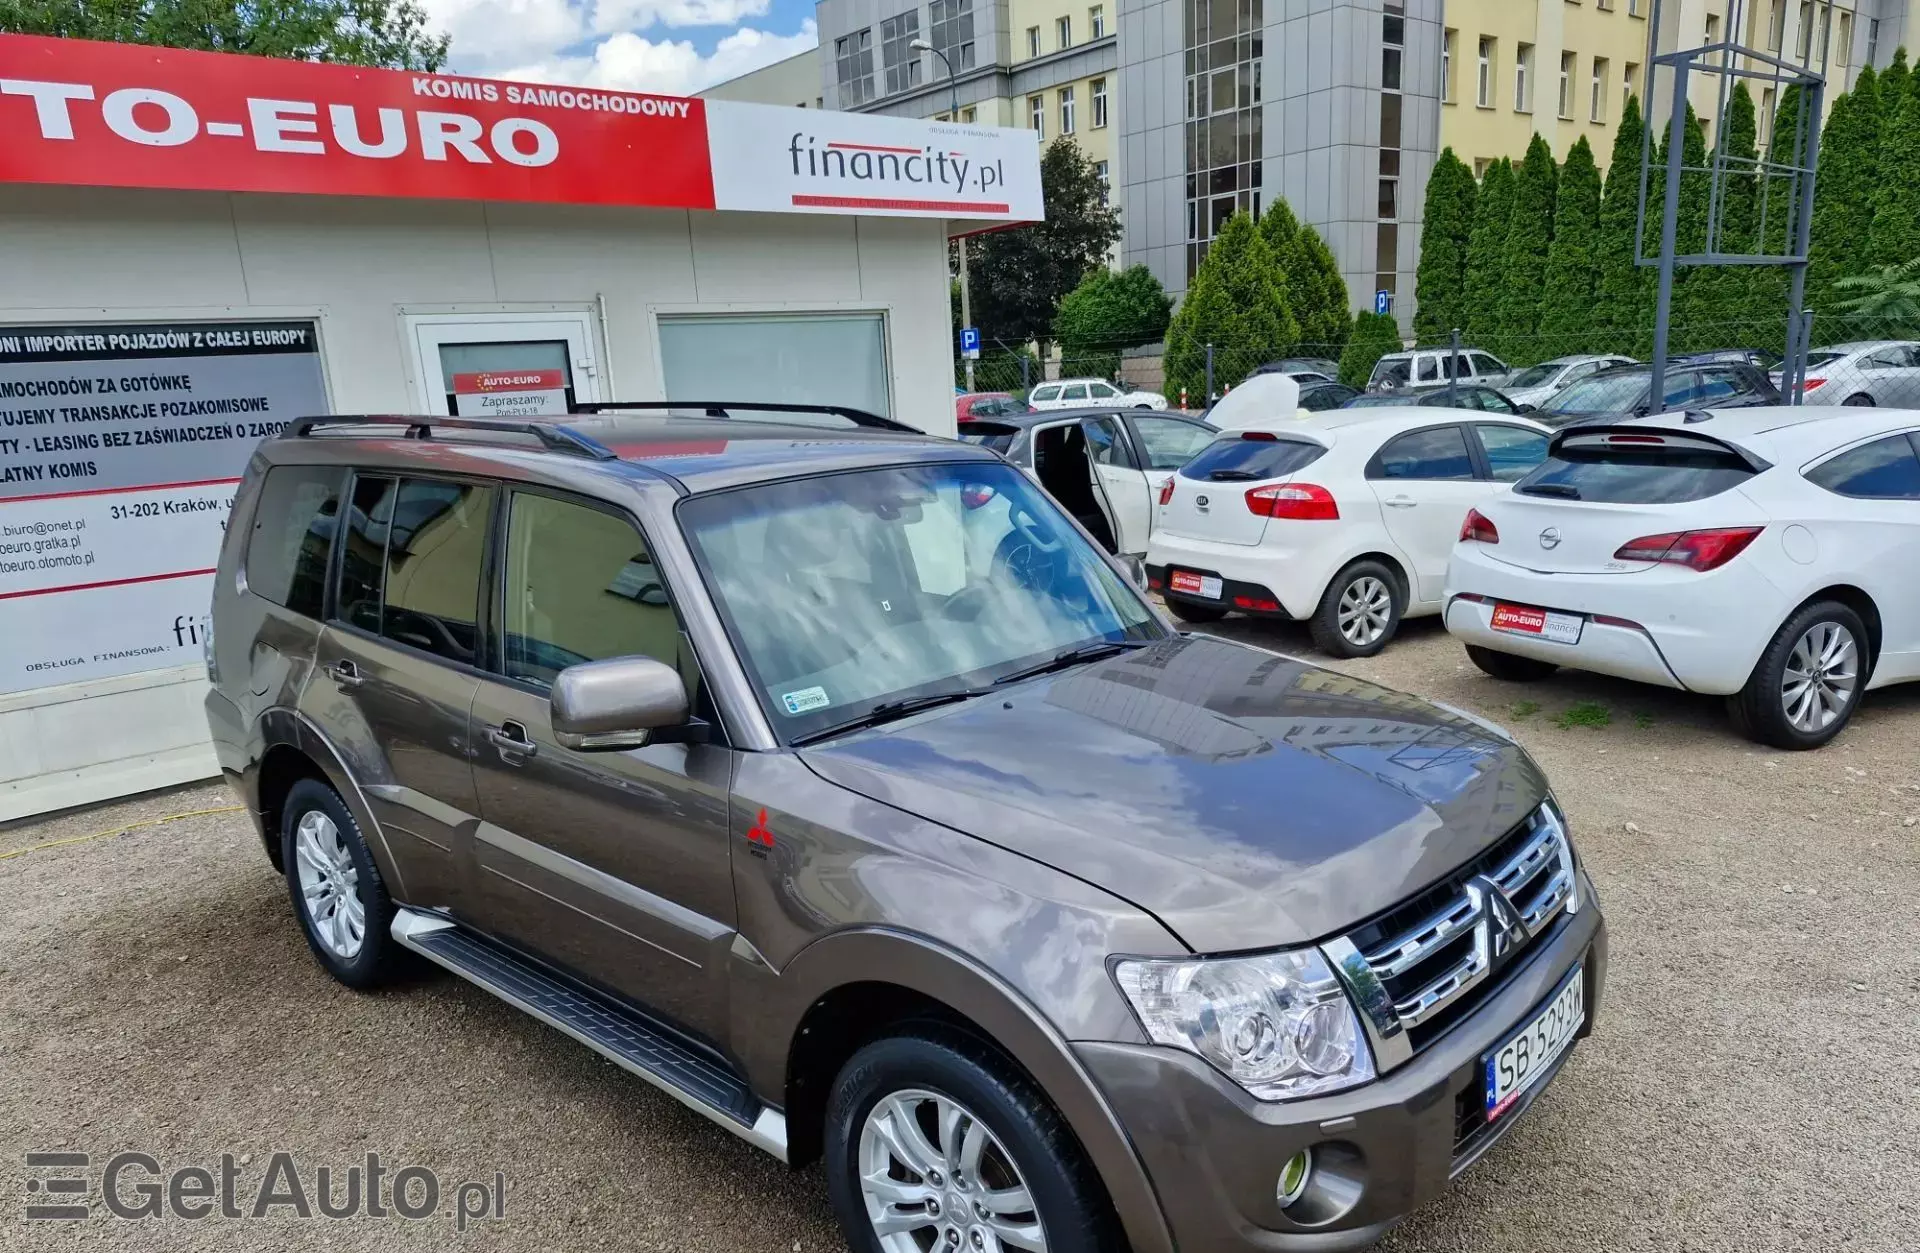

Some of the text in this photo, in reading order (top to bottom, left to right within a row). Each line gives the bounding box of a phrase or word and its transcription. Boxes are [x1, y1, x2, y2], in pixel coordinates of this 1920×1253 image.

[412, 77, 690, 118] KOMIS SAMOCHODOWY
[789, 132, 1005, 194] financity.pl
[24, 334, 107, 352] IMPORTER
[108, 329, 189, 350] POJAZDÓW
[193, 332, 203, 347] Z
[206, 330, 250, 347] CAŁEJ
[253, 329, 306, 345] EUROPY
[964, 331, 975, 348] P
[96, 378, 117, 394] ZA
[120, 374, 192, 393] GOTÓWKĘ
[483, 375, 541, 386] AUTO-EURO
[0, 397, 269, 427] UJEMY TRANSAKCJE POZAKOMISOWE
[482, 394, 549, 409] Zapraszamy:
[33, 434, 99, 452] LEASING
[103, 431, 131, 448] BEZ
[135, 422, 233, 445] ZAŚWIADCZEŃ
[236, 424, 246, 439] O
[0, 461, 97, 483] ATNY KOMIS
[111, 502, 160, 519] 31-202
[164, 498, 222, 514] Kraków,
[1498, 612, 1542, 627] AUTO-EURO
[26, 645, 171, 672] OBSŁUGA FINANSOWA:
[1500, 1034, 1529, 1092] SB
[1537, 974, 1582, 1060] 5293W
